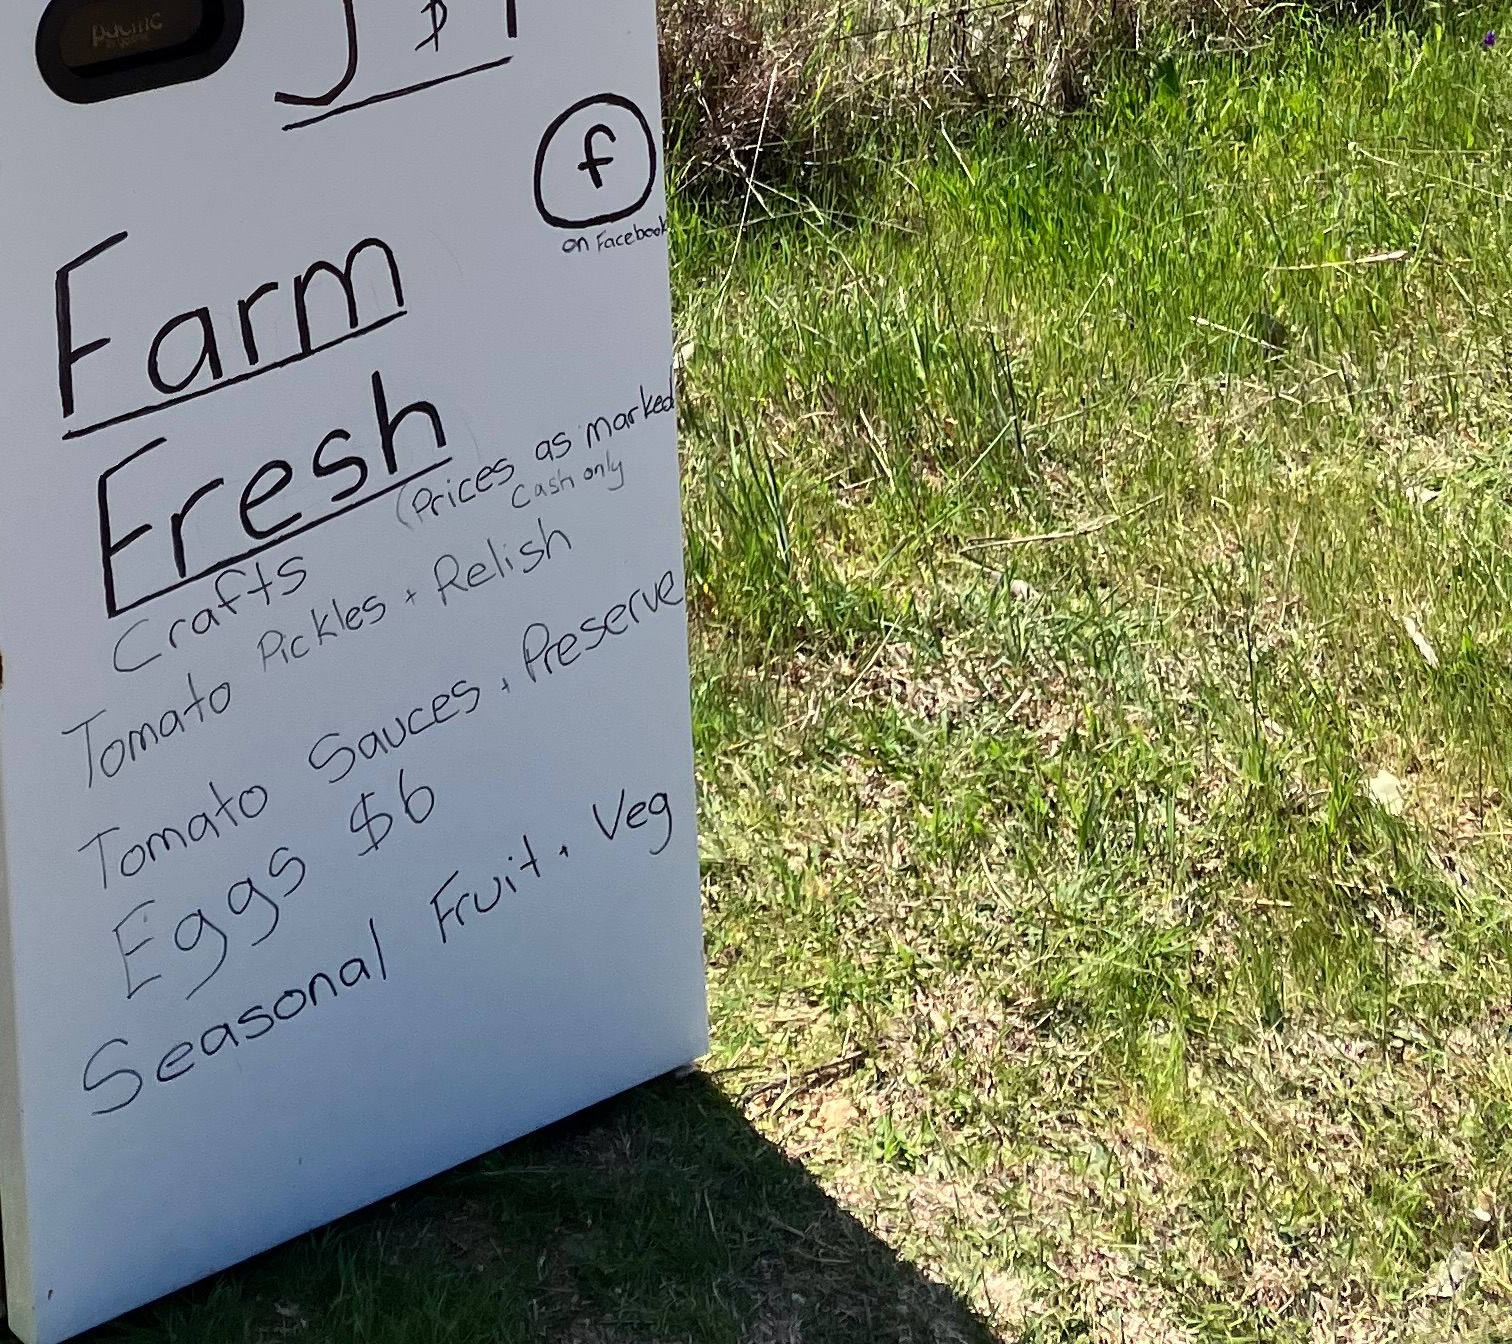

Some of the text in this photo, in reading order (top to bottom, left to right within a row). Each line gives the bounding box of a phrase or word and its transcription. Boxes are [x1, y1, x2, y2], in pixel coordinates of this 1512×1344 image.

[562, 215, 668, 254] on Facebook
[577, 124, 616, 189] f
[55, 231, 405, 416] Farm
[535, 431, 572, 462] as
[586, 365, 675, 449] marked
[98, 371, 447, 617] Fresh
[583, 450, 625, 491] only
[61, 674, 231, 788] Tomato
[257, 597, 387, 671] Pickles
[433, 517, 572, 605] Relish
[113, 557, 307, 672] Crafts
[79, 781, 268, 889] Tomato
[308, 677, 481, 784] Sauces
[83, 918, 388, 1115] Seasonal
[430, 835, 542, 943] Fruit
[593, 788, 673, 854] Veg
[112, 769, 435, 1000] Eggs $6
